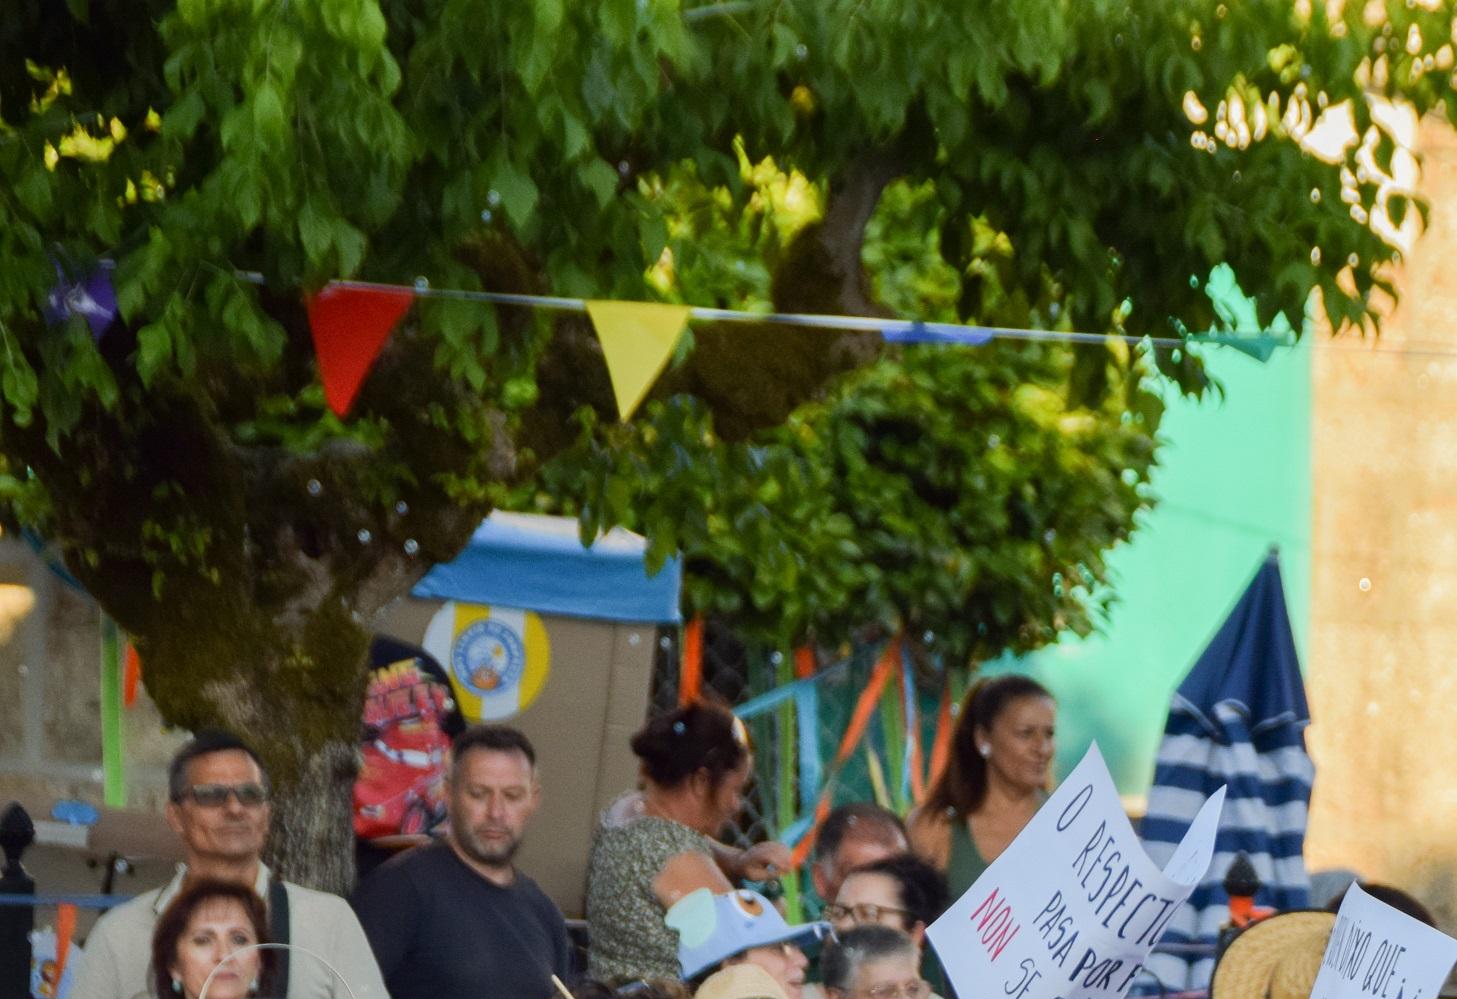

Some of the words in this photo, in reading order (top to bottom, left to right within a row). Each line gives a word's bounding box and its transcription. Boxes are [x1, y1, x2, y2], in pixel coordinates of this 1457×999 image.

[1056, 784, 1093, 832] O
[970, 887, 1021, 962] NON
[1033, 890, 1080, 968] PASA
[1068, 947, 1124, 990] POR
[1361, 939, 1406, 998] QUE
